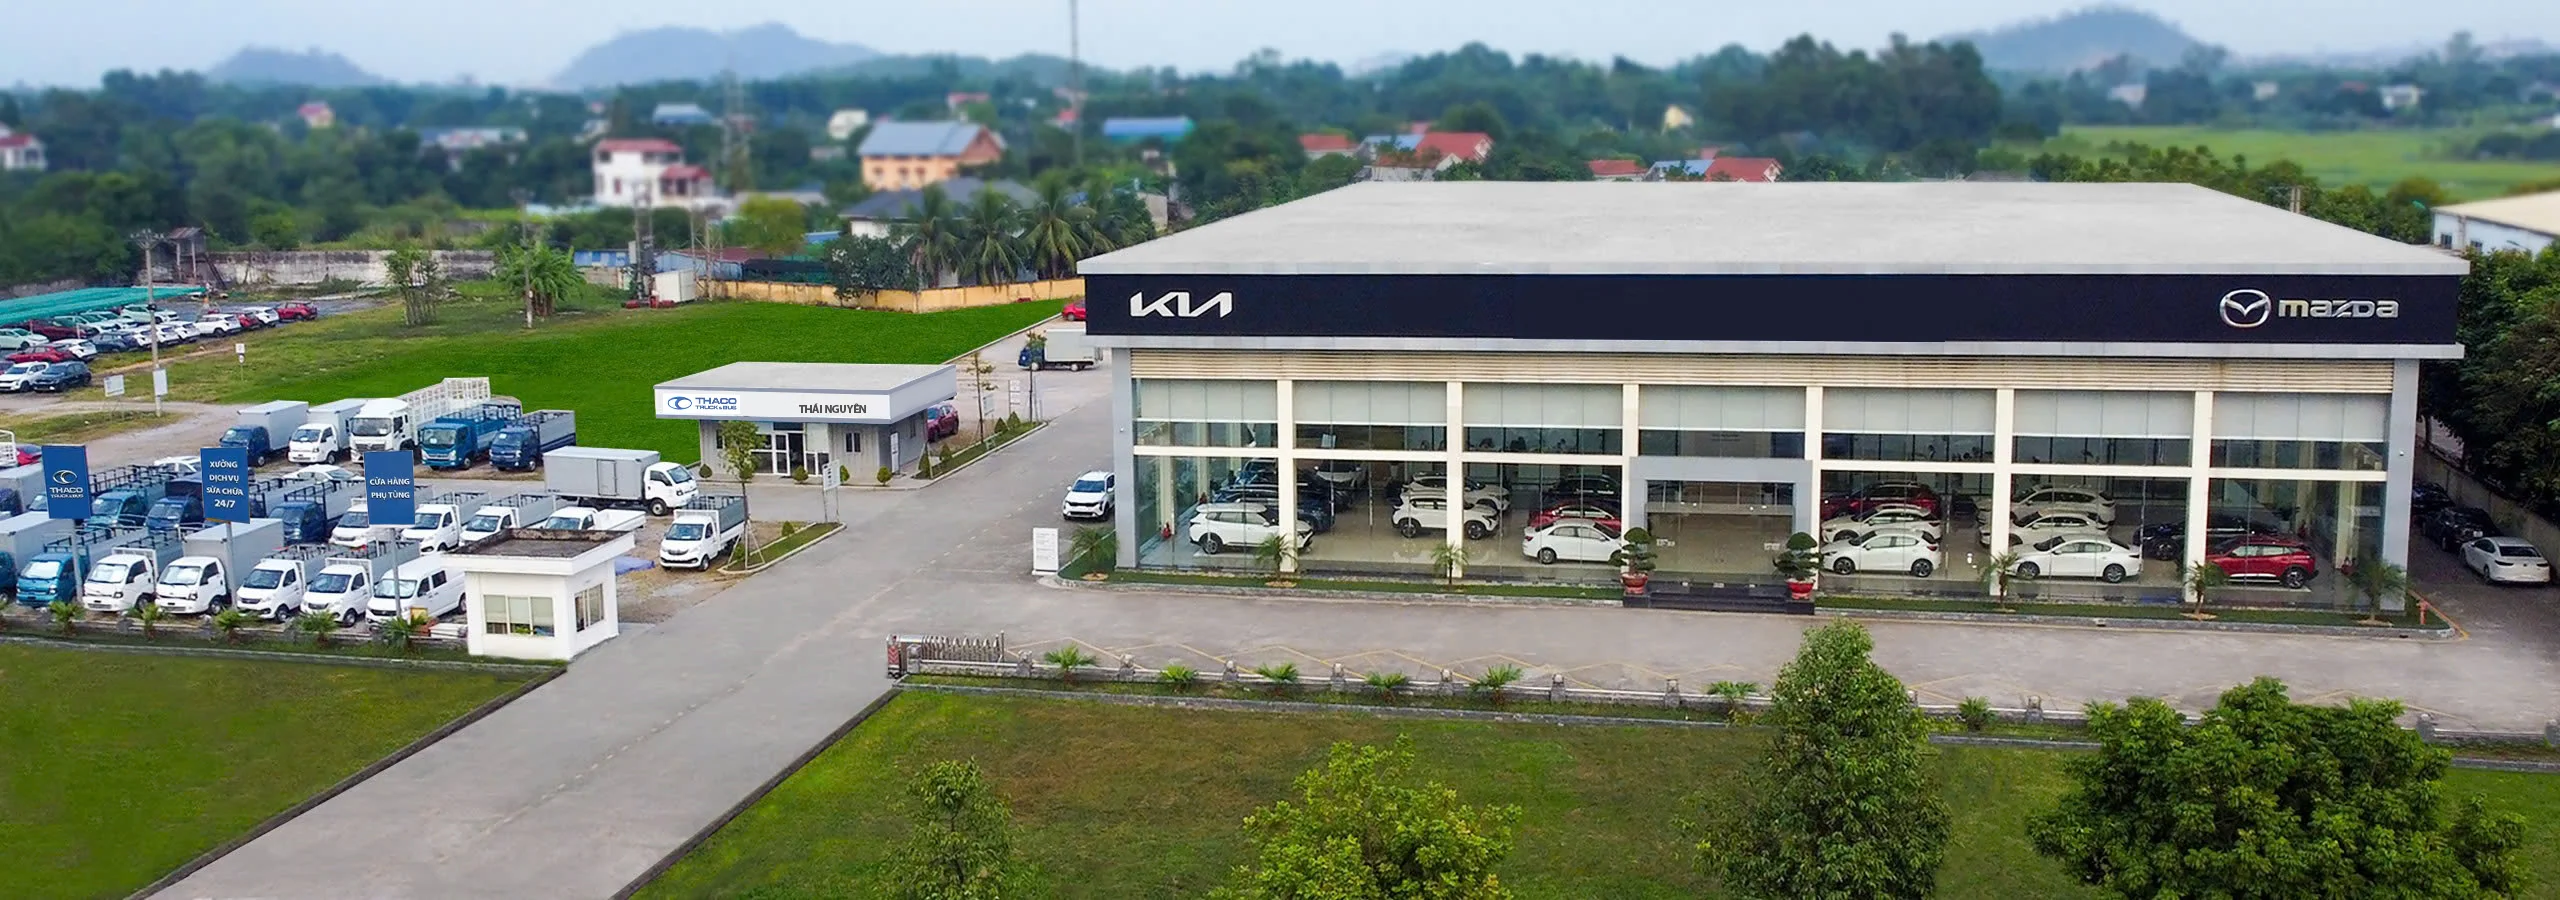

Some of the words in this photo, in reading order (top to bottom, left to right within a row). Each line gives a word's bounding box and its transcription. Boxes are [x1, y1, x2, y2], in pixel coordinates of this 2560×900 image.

[1130, 291, 1232, 318] KIA
[695, 397, 737, 405] THACO
[799, 403, 823, 414] THÁI
[825, 403, 867, 414] NGUYÊN
[209, 459, 238, 468] XƯỞNG
[209, 474, 228, 482] DỊCH
[228, 474, 239, 483] VỤ
[369, 476, 386, 486] CỬA
[387, 476, 410, 485] HÀNG
[206, 486, 221, 494] SỬA
[371, 492, 387, 500] PHỤ
[388, 490, 410, 499] TÙNG
[214, 499, 236, 508] 24/7
